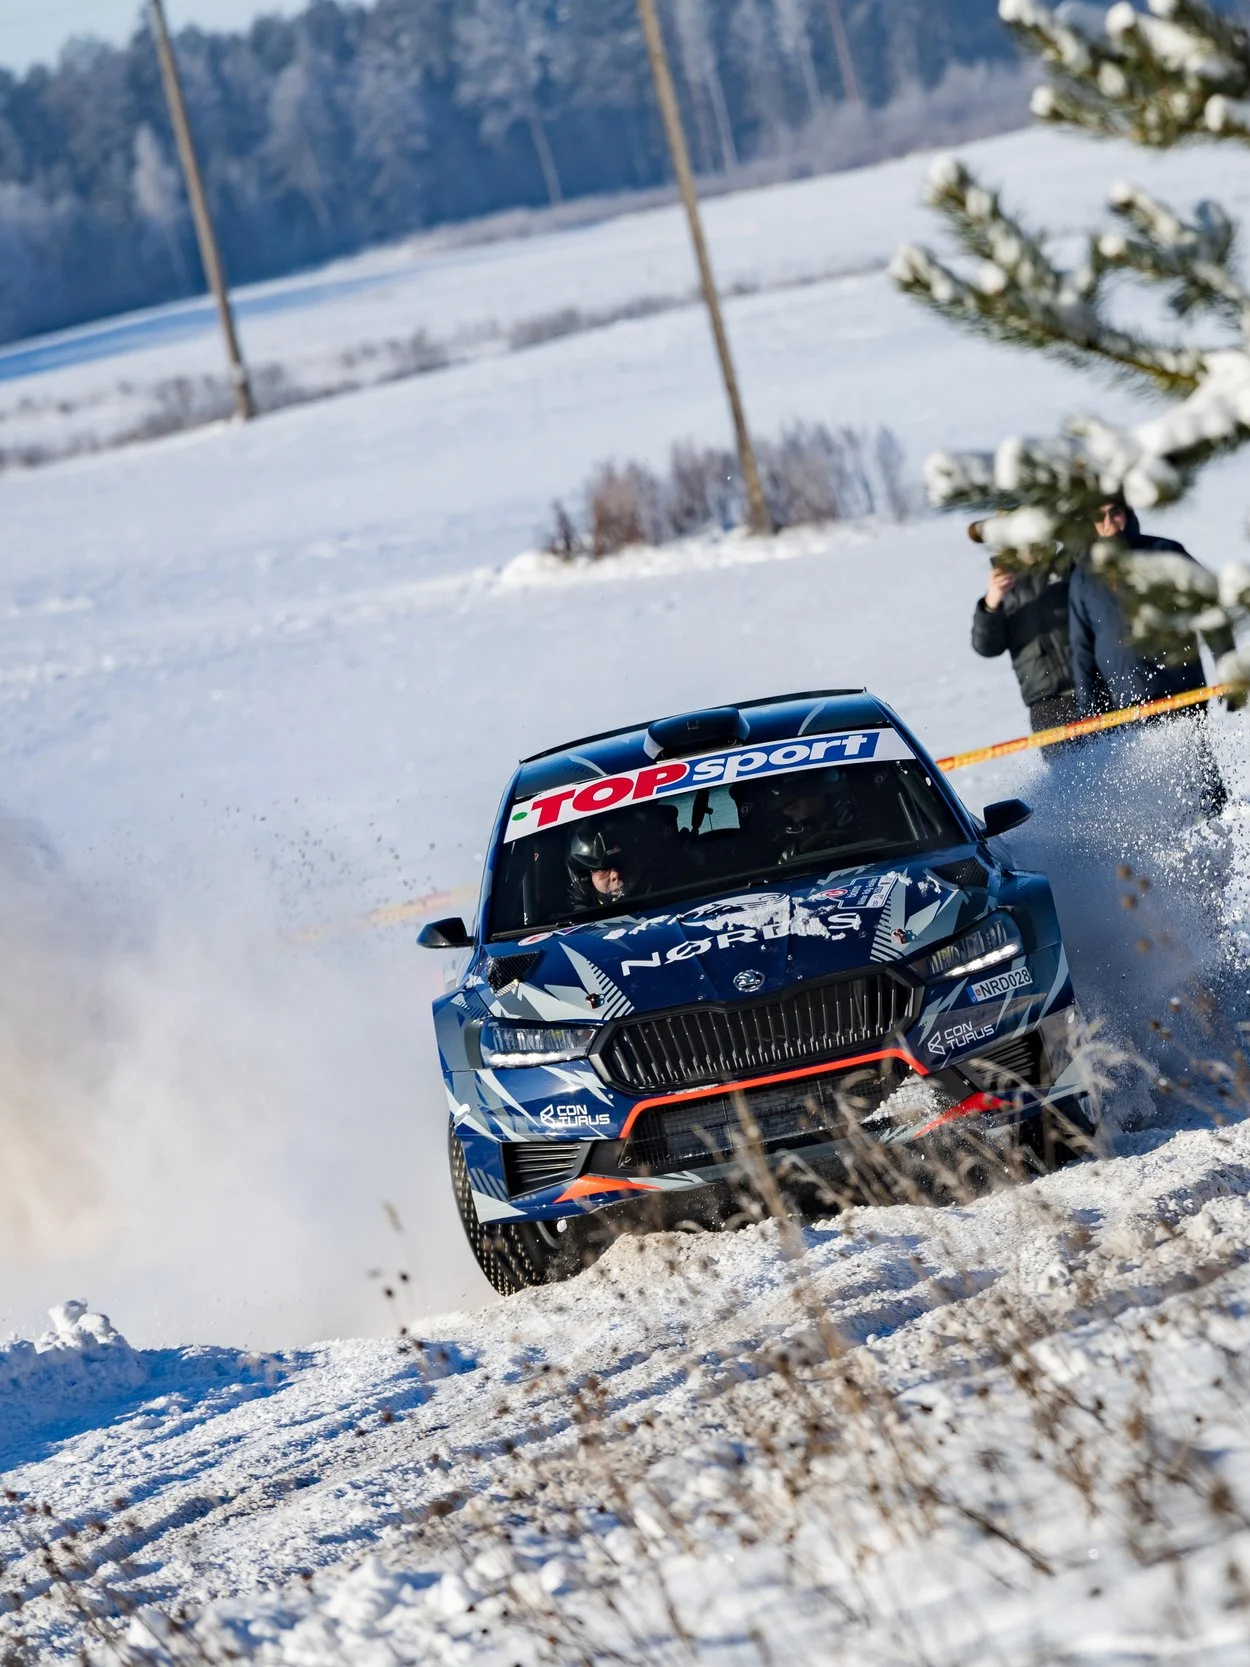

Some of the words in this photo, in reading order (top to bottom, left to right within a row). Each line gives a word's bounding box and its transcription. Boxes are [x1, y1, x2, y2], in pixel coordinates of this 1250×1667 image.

[980, 969, 1031, 997] NRD028
[944, 1020, 973, 1040] CON
[946, 1024, 995, 1050] TURUS
[556, 1104, 588, 1116] CON
[558, 1114, 610, 1126] TURUS
